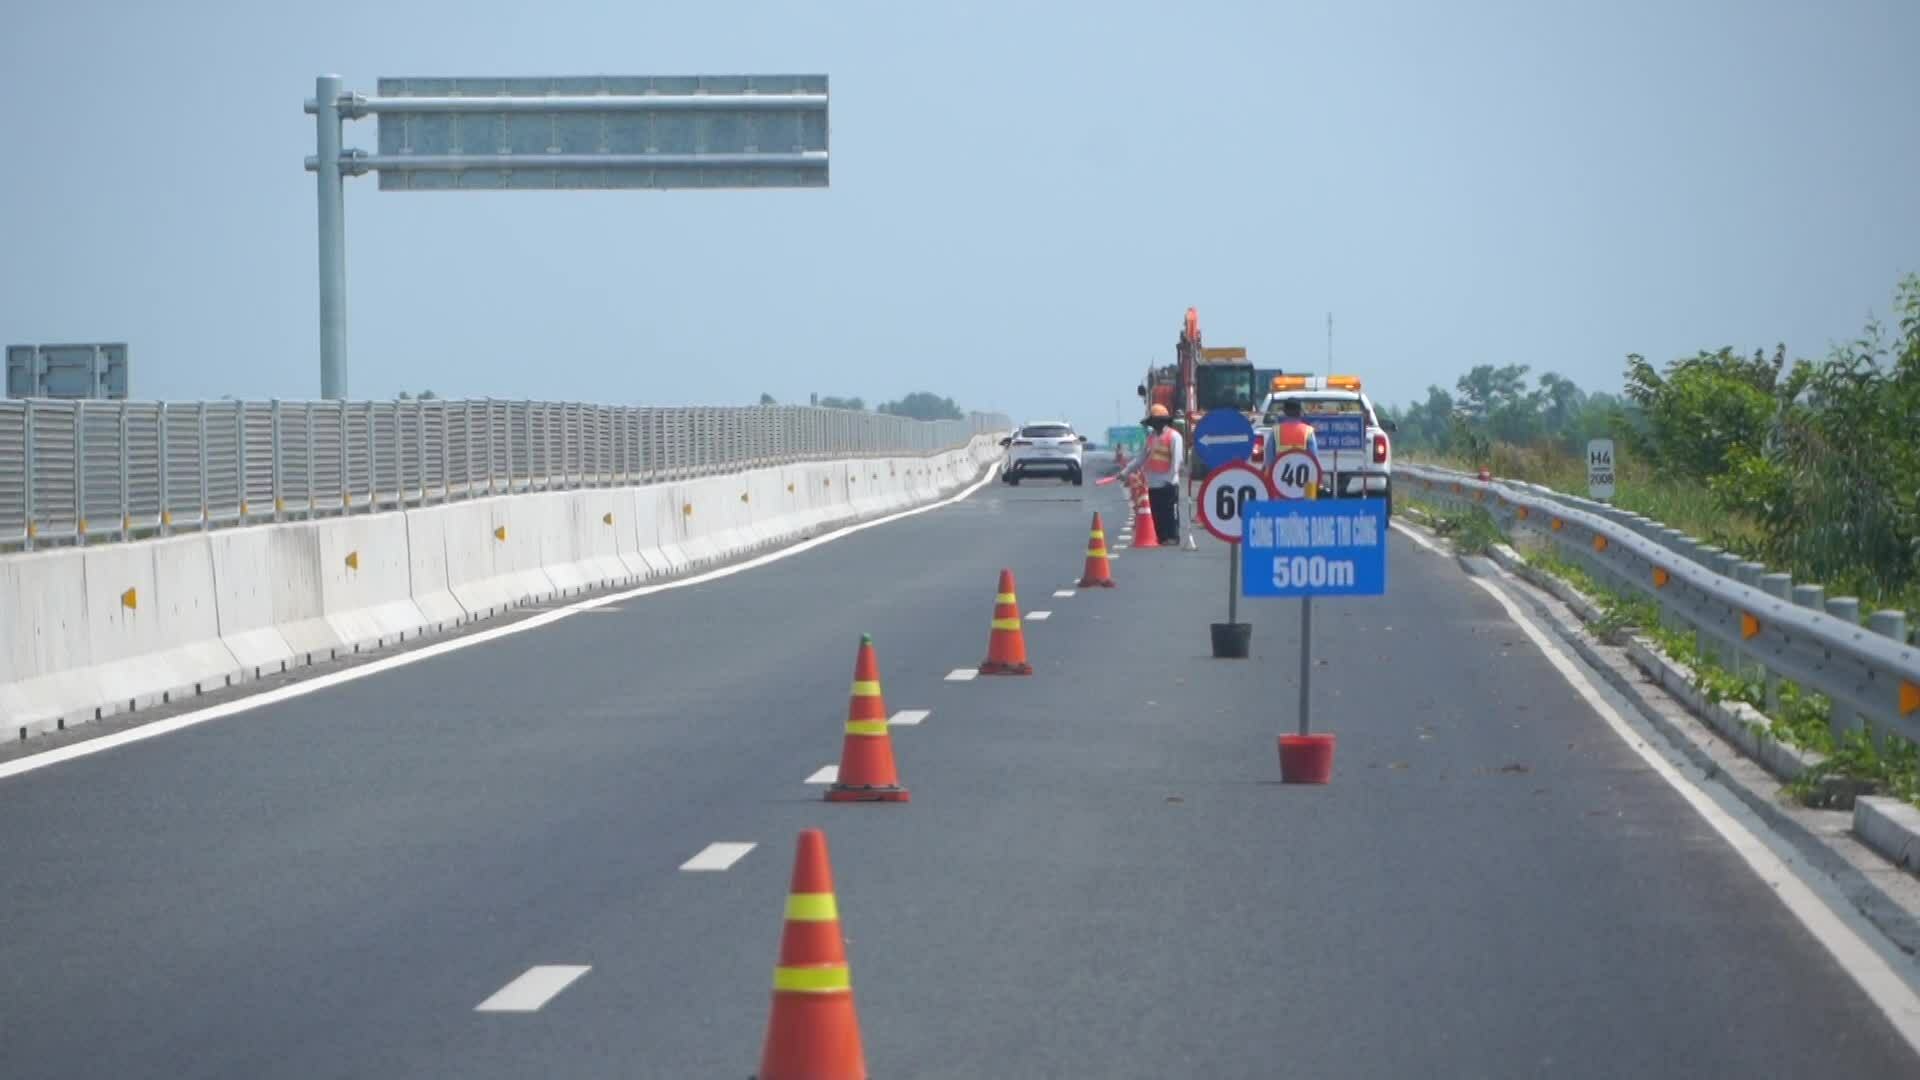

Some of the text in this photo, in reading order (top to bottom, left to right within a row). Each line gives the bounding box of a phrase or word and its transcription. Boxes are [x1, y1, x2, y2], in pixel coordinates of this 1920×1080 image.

[1591, 451, 1610, 465] H4
[1280, 463, 1309, 488] 40
[1216, 485, 1256, 521] 60
[1249, 511, 1273, 548] CÔNG
[1336, 514, 1351, 547] THI
[1352, 509, 1377, 547] CÔNG
[1272, 555, 1354, 588] 500m
